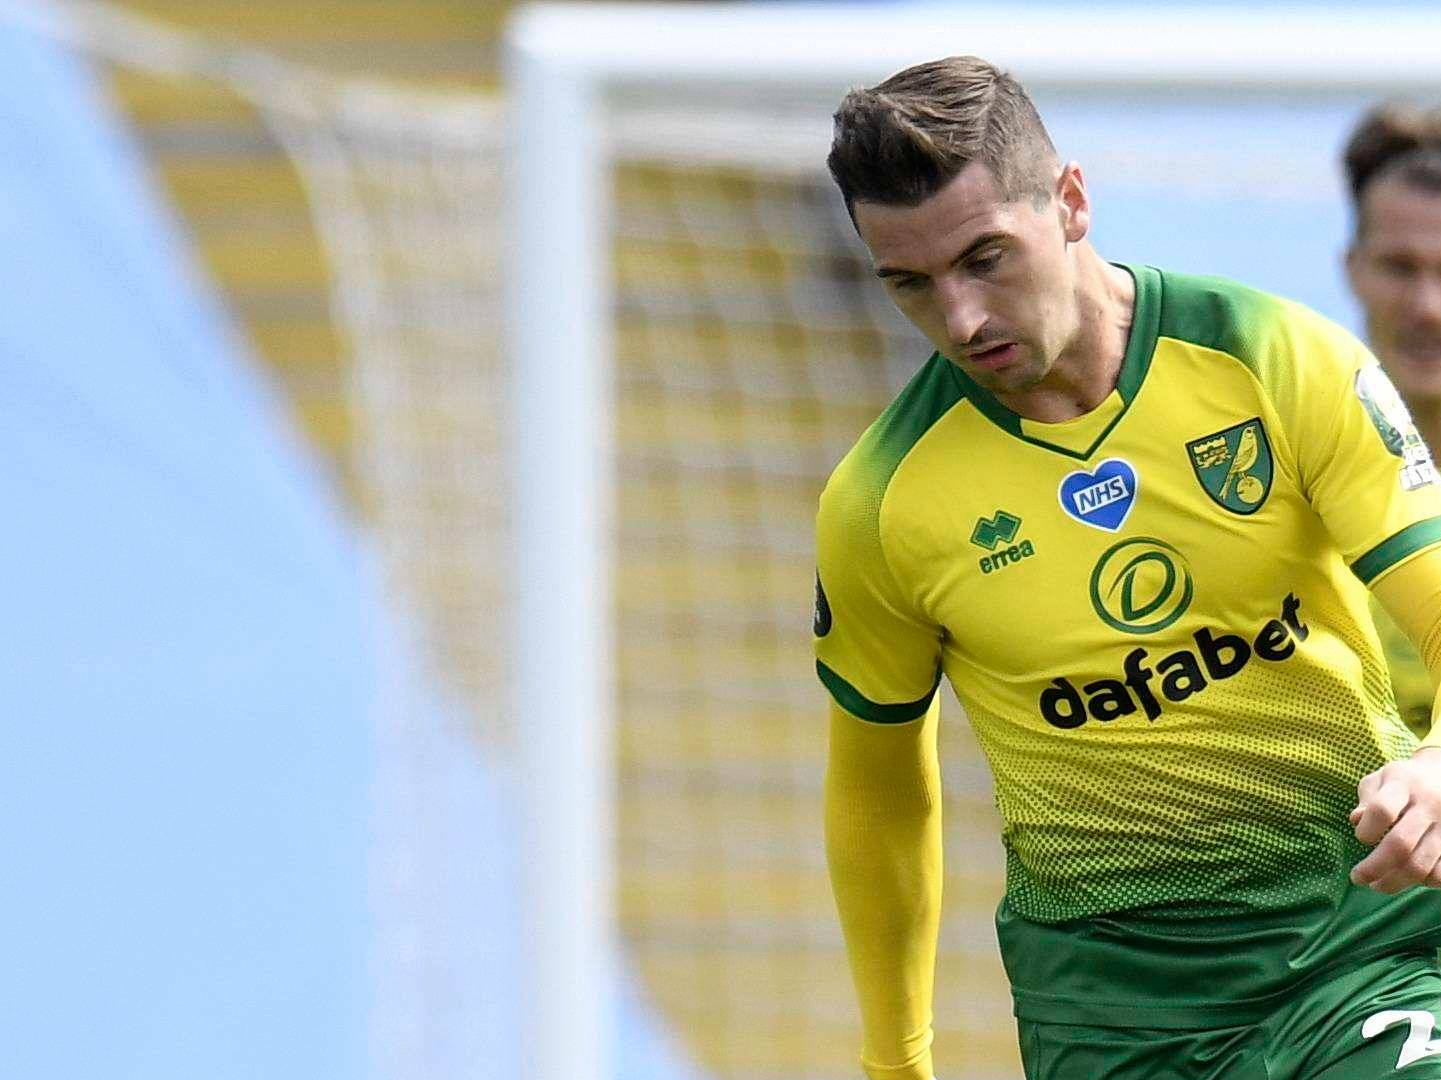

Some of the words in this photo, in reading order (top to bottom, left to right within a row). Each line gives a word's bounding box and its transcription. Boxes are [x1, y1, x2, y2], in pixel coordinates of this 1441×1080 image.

[1079, 478, 1124, 511] NHS
[978, 538, 1035, 574] errea
[1039, 592, 1311, 729] dafabet
